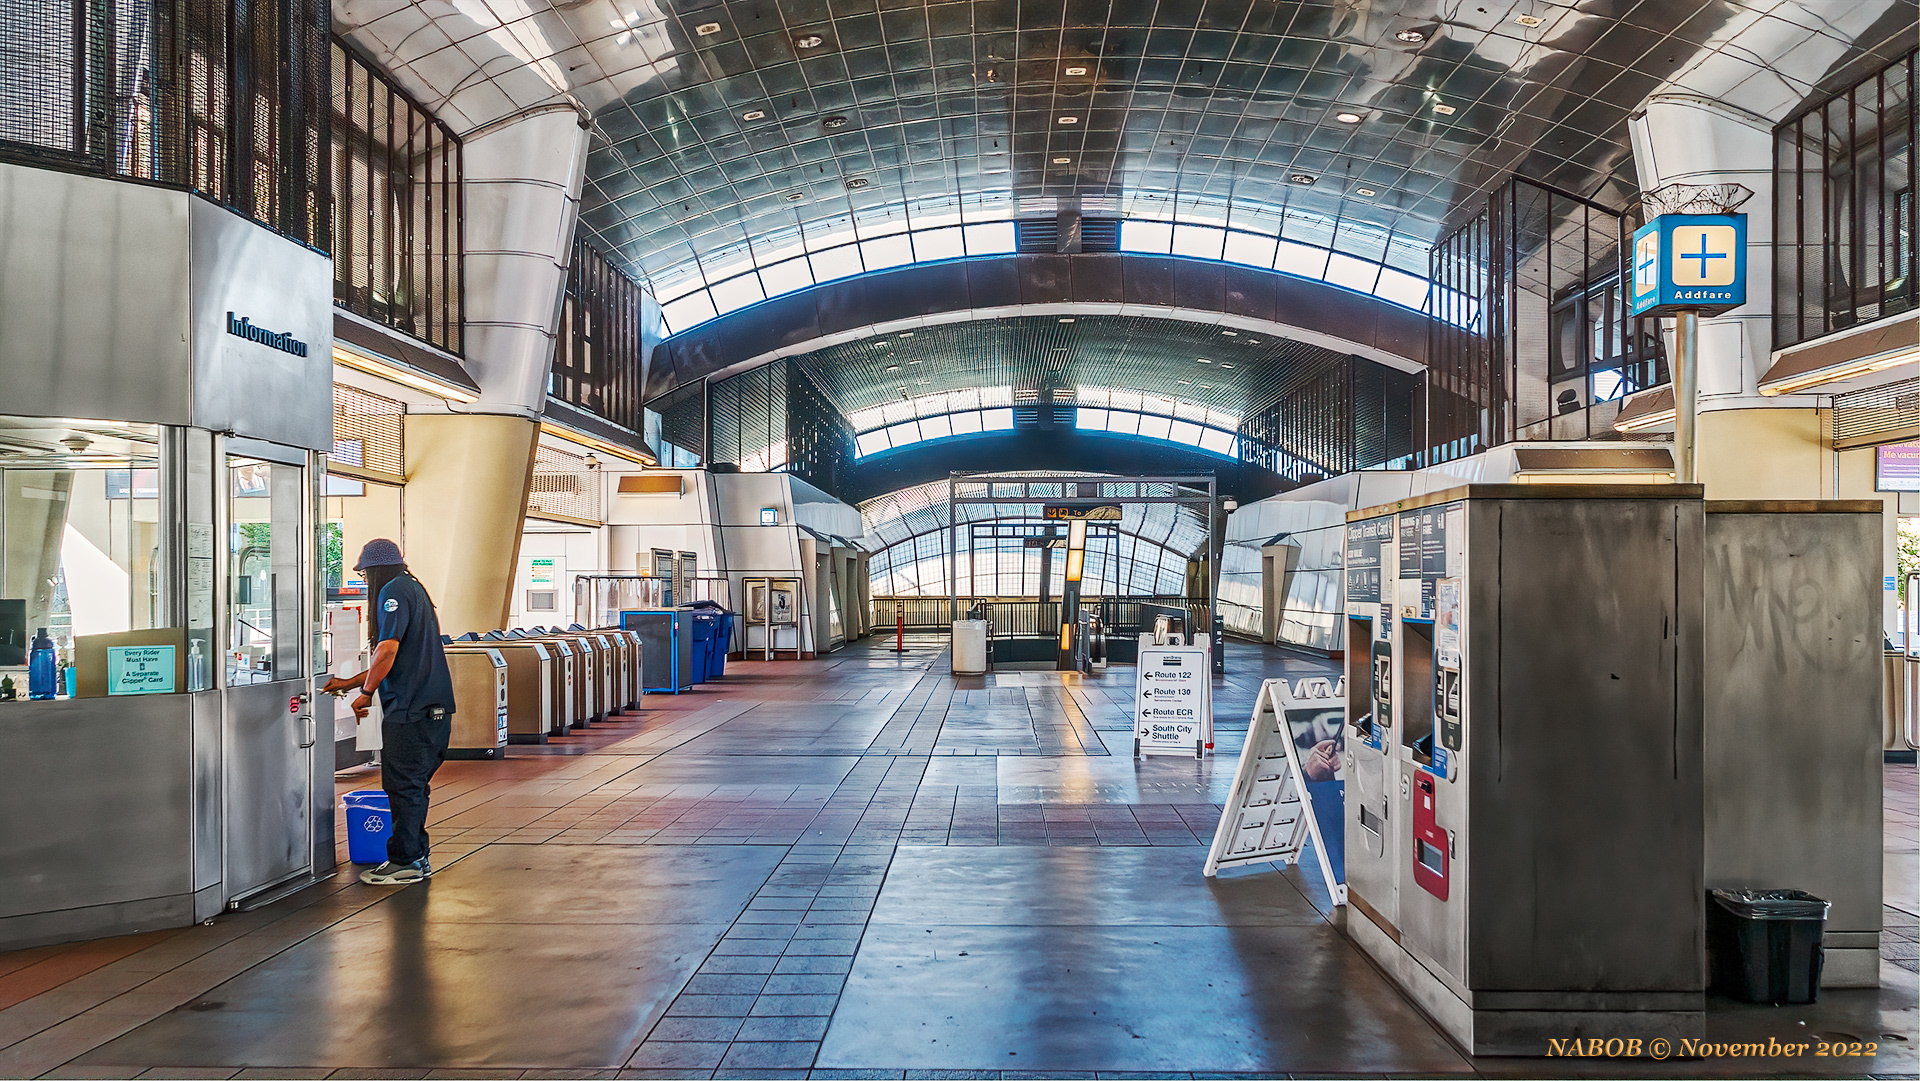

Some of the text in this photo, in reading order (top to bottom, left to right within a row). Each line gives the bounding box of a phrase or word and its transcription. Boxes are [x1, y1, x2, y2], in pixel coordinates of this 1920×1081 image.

[1674, 290, 1732, 299] Addfare
[1636, 296, 1656, 309] Addfare
[226, 311, 308, 358] Information
[1347, 520, 1389, 541] Clipper Transit Card
[1154, 671, 1192, 679] Route 122
[1153, 687, 1191, 696] Route 130
[1152, 708, 1193, 716] Route ECR
[1152, 724, 1193, 734] South City
[1152, 732, 1179, 740] Shuttle
